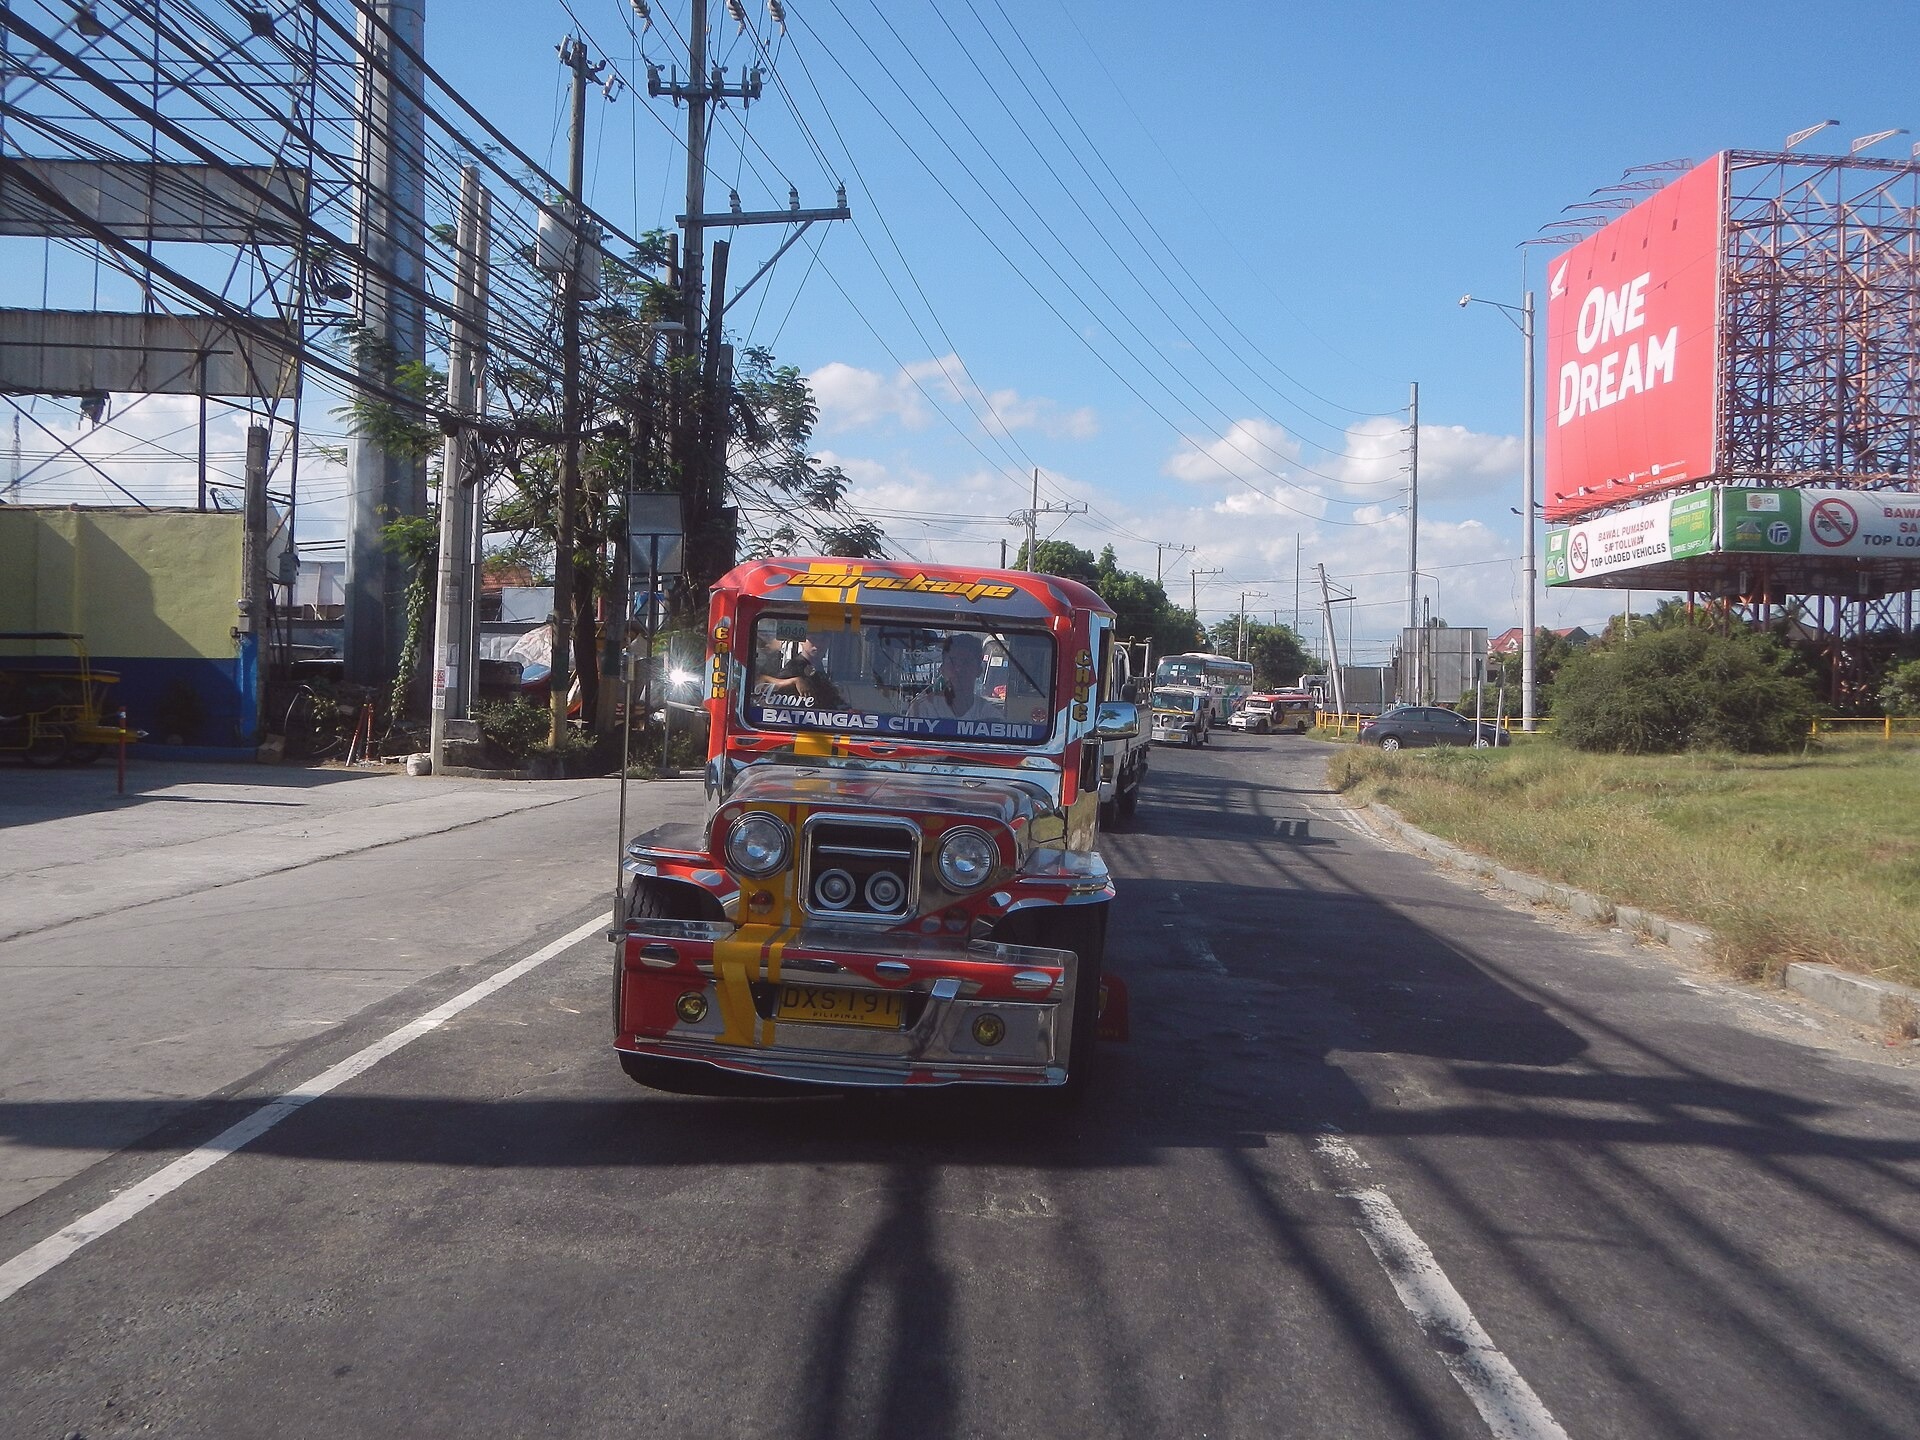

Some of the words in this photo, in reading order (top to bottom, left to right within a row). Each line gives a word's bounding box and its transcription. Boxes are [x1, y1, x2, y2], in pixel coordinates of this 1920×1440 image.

[1577, 271, 1650, 354] ONE
[1558, 325, 1678, 427] DREAM
[1598, 529, 1620, 541] BAWAL
[1622, 519, 1655, 536] PUMASOK
[1862, 534, 1892, 546] TOP
[1900, 522, 1918, 533] SA
[1591, 556, 1603, 568] TOP
[1604, 552, 1631, 566] LOADED
[1632, 543, 1667, 560] VEHICLES
[753, 683, 815, 708] Amore
[762, 708, 879, 730] BATANGAS
[888, 717, 941, 733] CITY
[957, 720, 1033, 739] MABINI
[783, 987, 836, 1009] DXS
[848, 992, 891, 1015] 191
[813, 1012, 865, 1021] PILIPINAS
